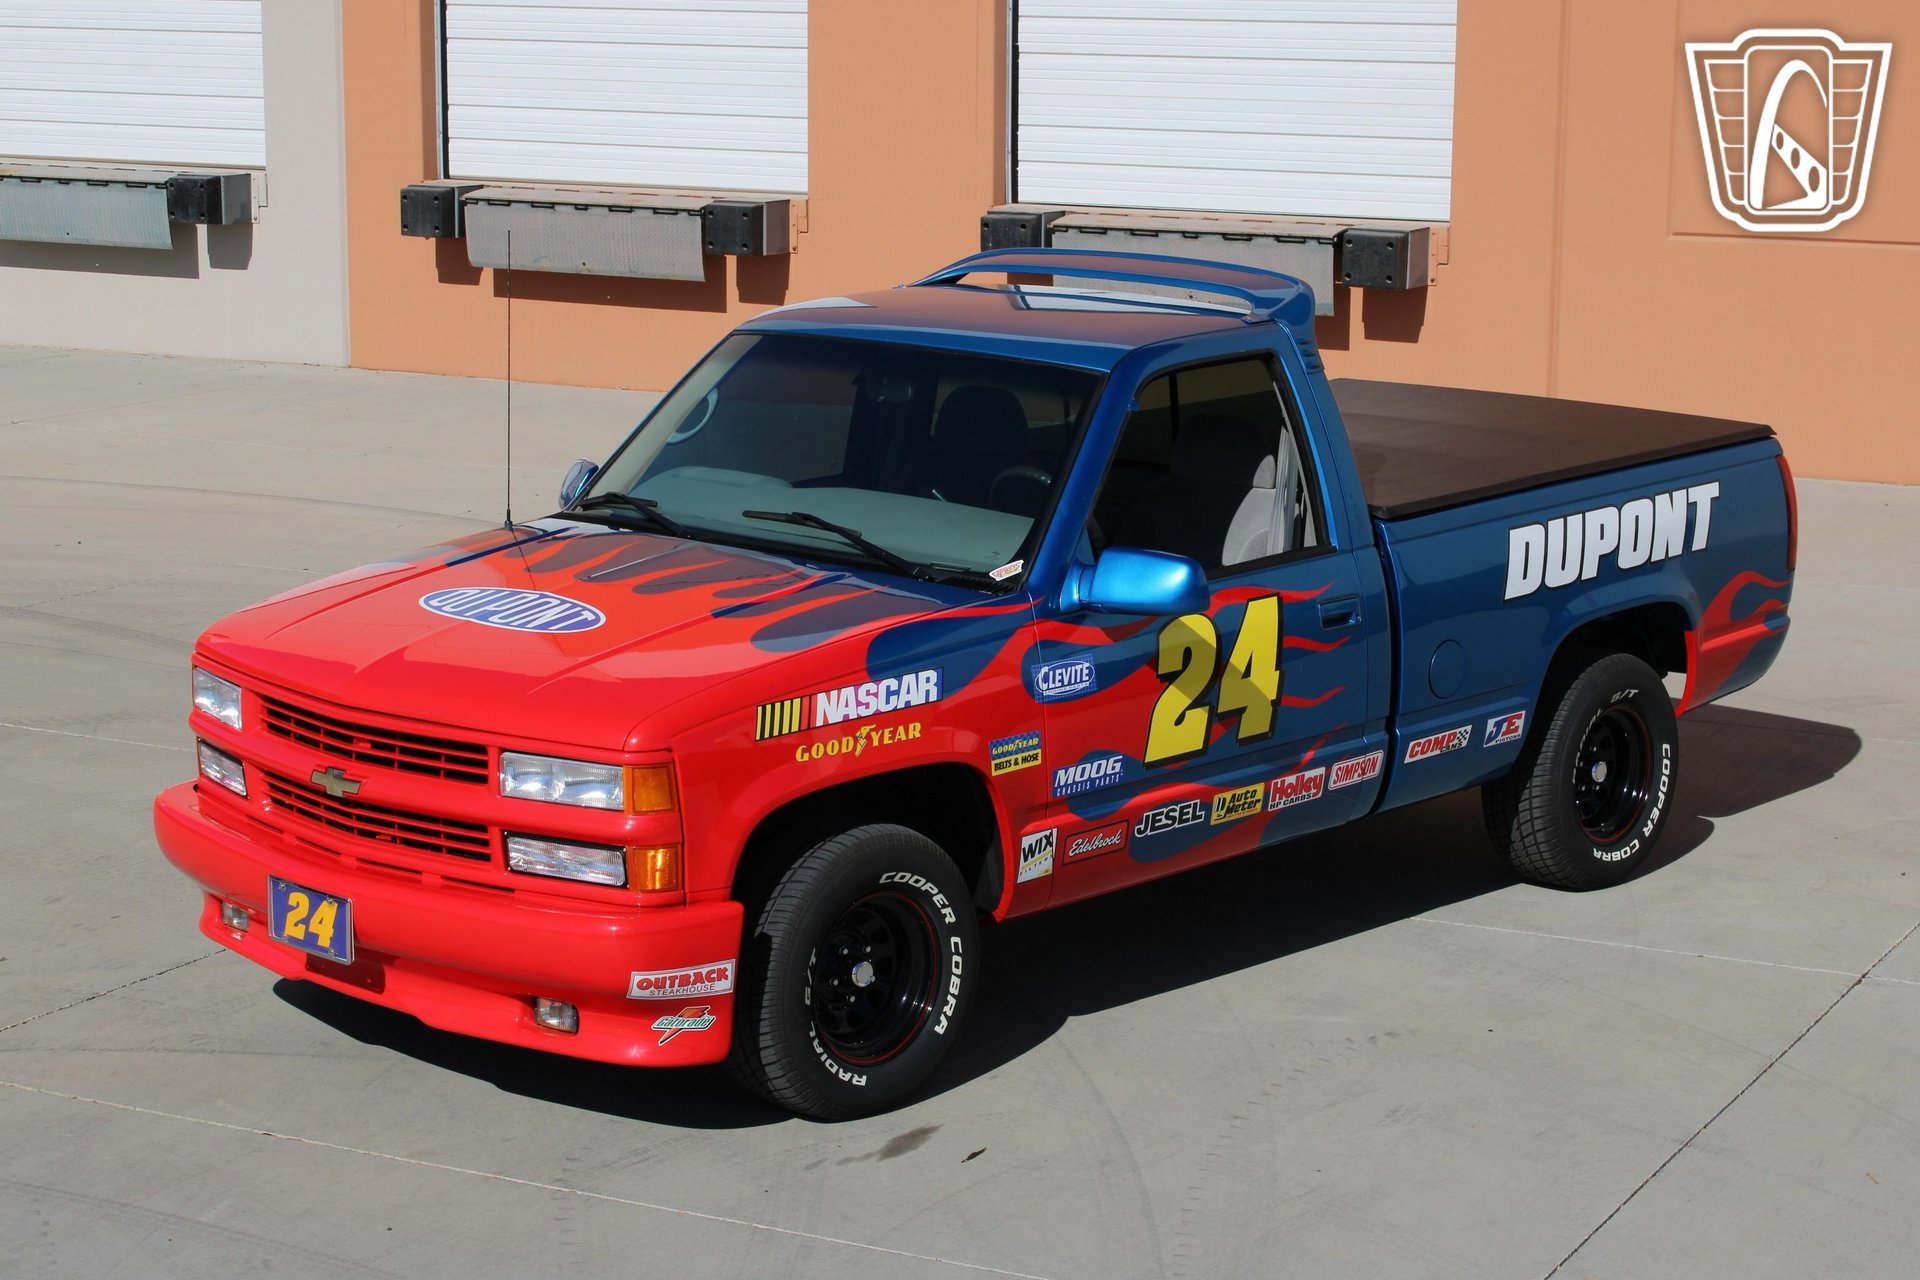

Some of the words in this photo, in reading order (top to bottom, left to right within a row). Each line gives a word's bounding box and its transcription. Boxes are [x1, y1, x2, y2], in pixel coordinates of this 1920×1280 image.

[1503, 480, 1720, 602] DUPONT
[1038, 663, 1091, 691] CLEVITE
[1144, 589, 1281, 766] 24
[815, 669, 938, 728] NASCAR
[1484, 712, 1524, 746] JE
[1408, 731, 1458, 759] COMP
[994, 760, 1013, 772] BELTS
[1013, 757, 1020, 767] &
[1020, 752, 1040, 766] HOSE
[1054, 755, 1124, 788] MOOG
[1332, 754, 1379, 786] SIMPSON
[1056, 781, 1091, 797] CHASSIS
[1095, 774, 1120, 788] PARTS
[1228, 789, 1258, 805] Auto
[1269, 772, 1324, 803] Holley
[1642, 743, 1672, 838] COOPER
[1225, 798, 1262, 816] Meter
[1269, 800, 1281, 811] HP
[1282, 793, 1312, 807] CARBS
[1134, 799, 1206, 838] JESEL
[1022, 830, 1053, 863] WIX
[1068, 828, 1122, 857] Edelbrock
[1593, 838, 1641, 862] COBRA
[284, 891, 338, 949] 24
[879, 871, 957, 925] COOPER
[934, 936, 962, 1035] COBRA
[636, 966, 729, 991] OUTBACK
[649, 983, 716, 997] STEAKHOUSE
[656, 1015, 713, 1028] Gatorade
